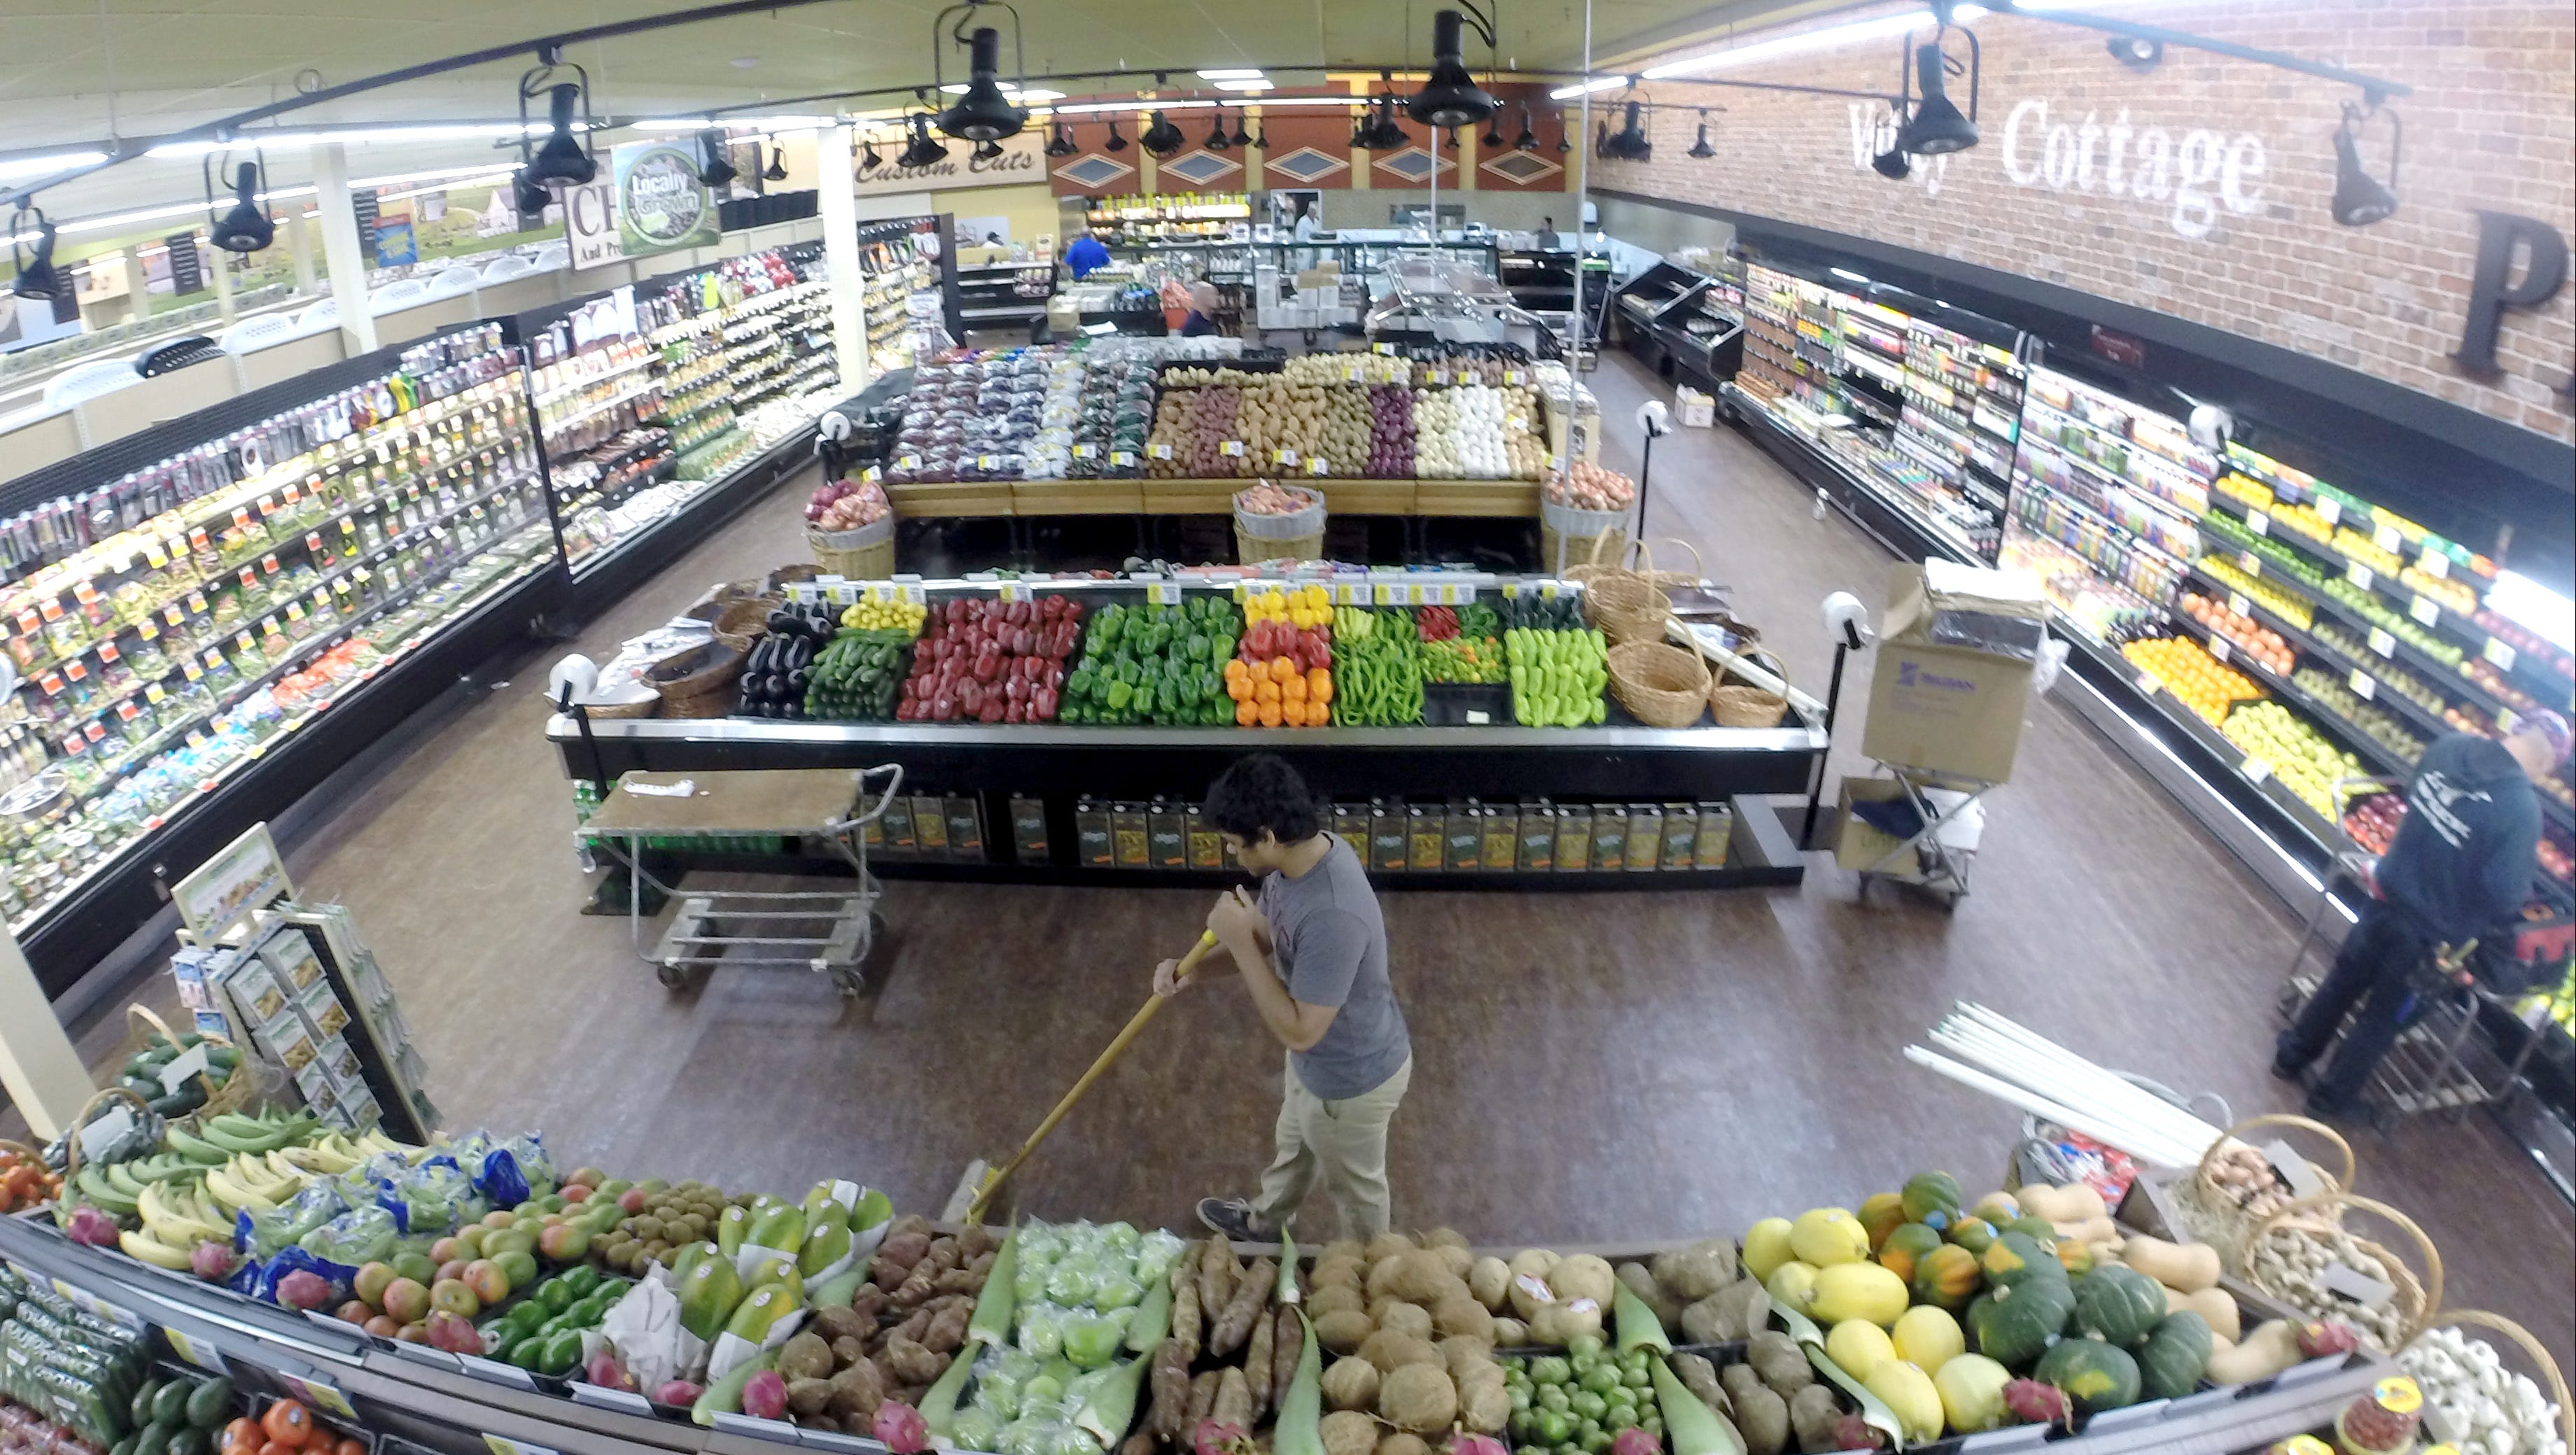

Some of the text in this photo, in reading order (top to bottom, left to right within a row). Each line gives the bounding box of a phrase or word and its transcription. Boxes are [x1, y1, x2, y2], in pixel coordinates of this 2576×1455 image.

[969, 150, 1032, 173] Cuts
[2002, 99, 2266, 238] Cottage
[632, 170, 688, 195] Locally
[640, 193, 699, 215] Grown
[580, 244, 601, 262] And
